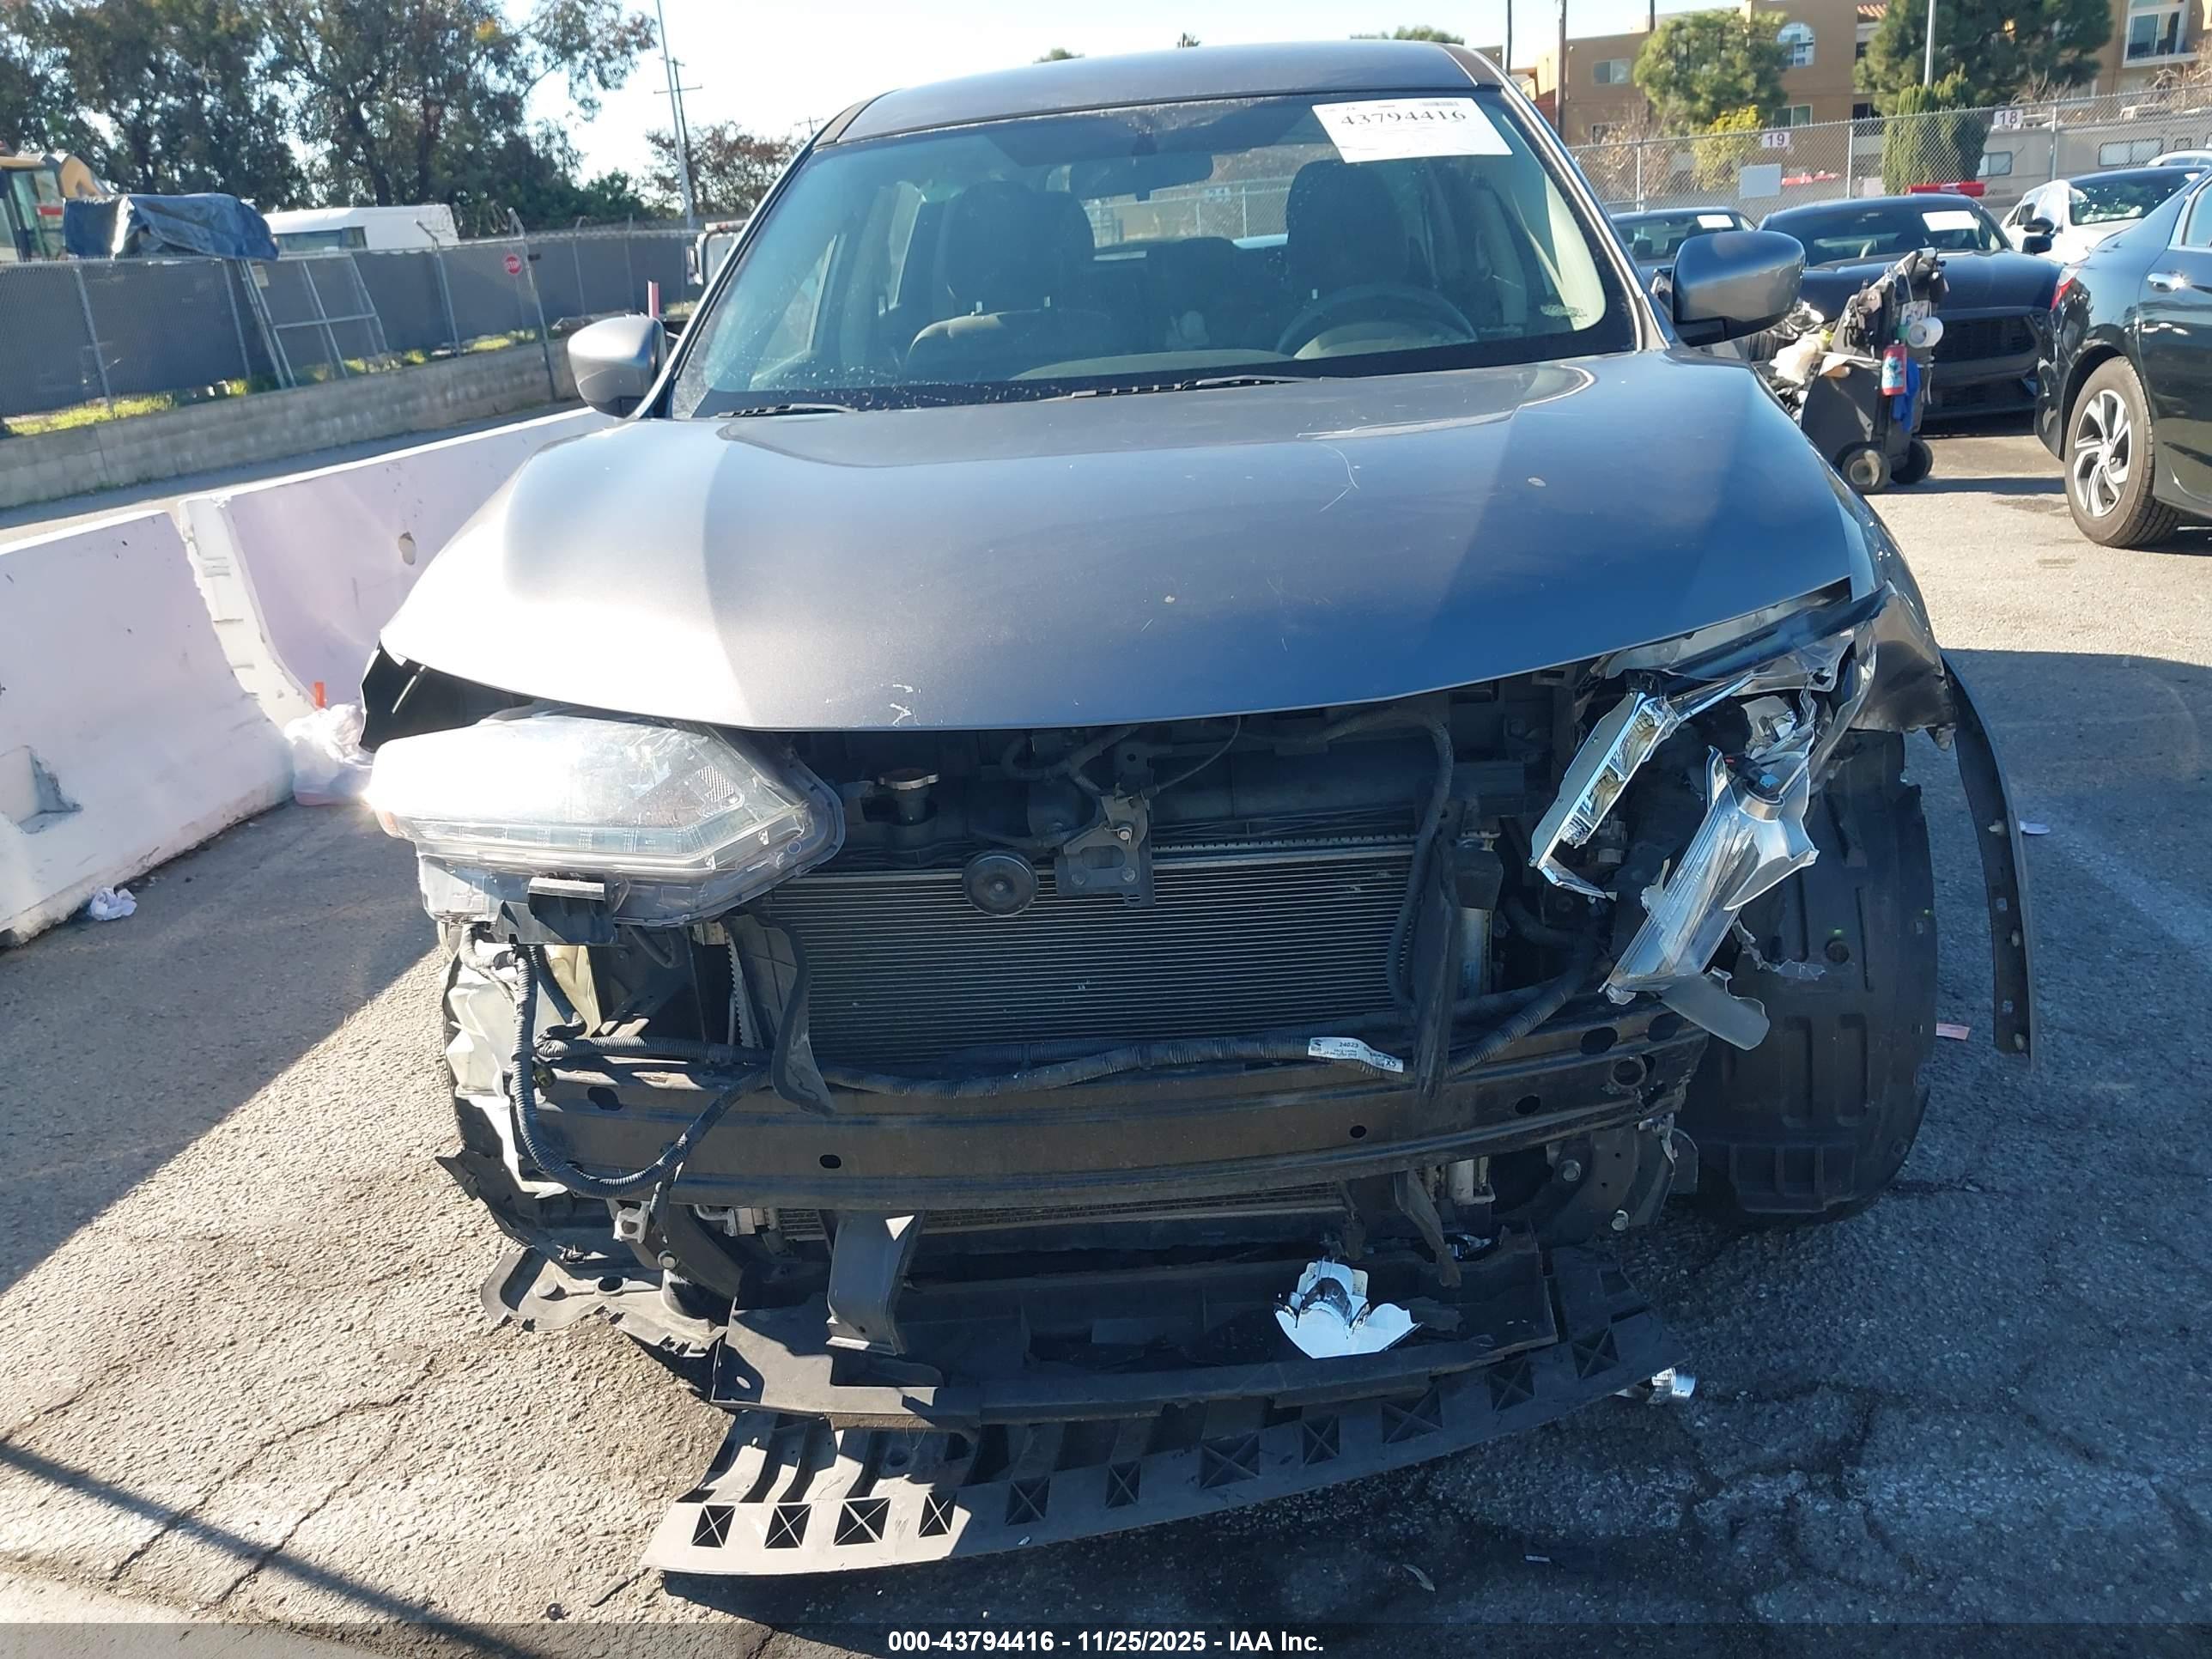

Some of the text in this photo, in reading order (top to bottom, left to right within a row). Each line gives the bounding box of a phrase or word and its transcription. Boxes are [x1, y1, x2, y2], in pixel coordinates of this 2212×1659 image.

[1341, 110, 1467, 125] 43794416
[2000, 111, 2018, 125] 18
[1767, 132, 1785, 146] 19
